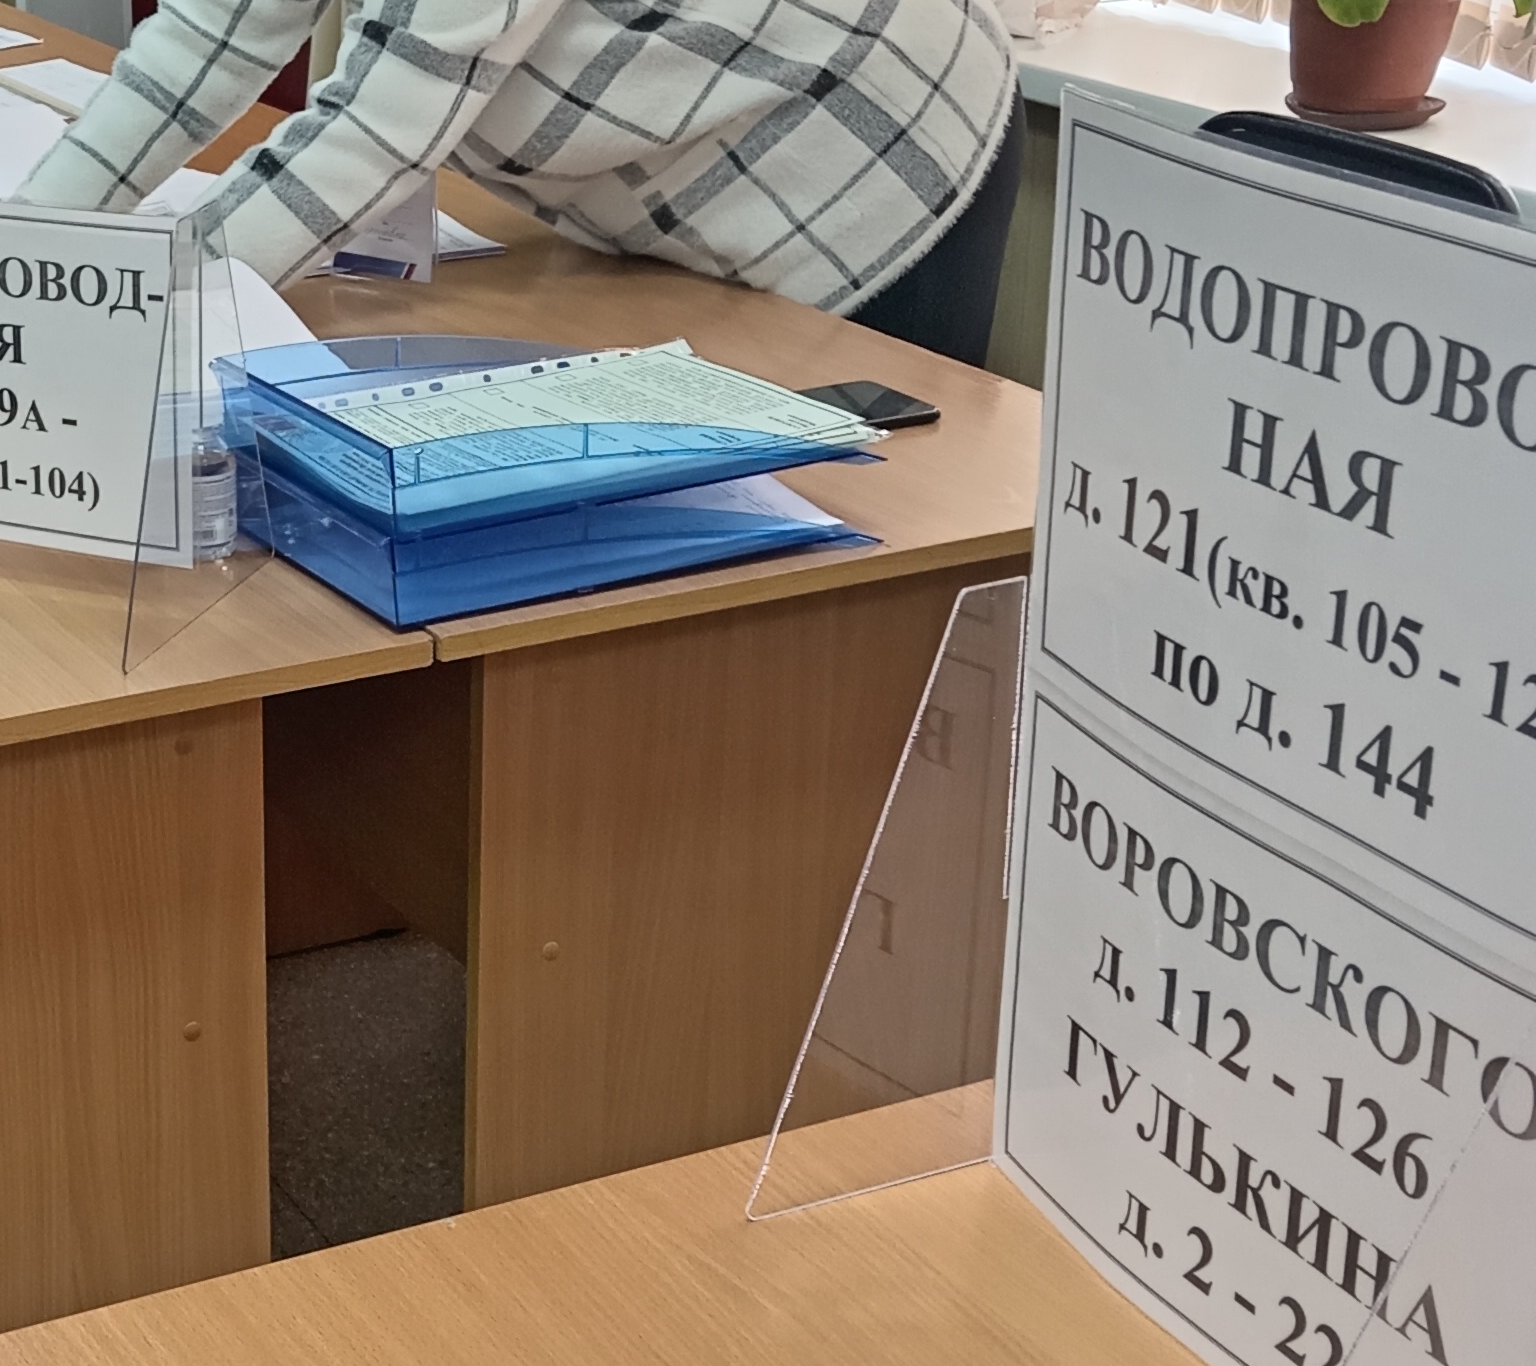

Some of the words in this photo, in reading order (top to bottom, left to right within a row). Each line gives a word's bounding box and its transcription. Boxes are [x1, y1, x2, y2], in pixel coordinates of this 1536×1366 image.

[1063, 460, 1102, 528] д.
[1118, 476, 1305, 631] 121(кв.
[1325, 589, 1425, 679] 105
[1221, 397, 1404, 540] НАЯ
[1150, 629, 1220, 707] по
[1235, 678, 1292, 752] д.
[1318, 702, 1435, 821] 144
[1047, 765, 1536, 1141] ВОРОВСКОГО
[1092, 934, 1136, 1004] д.
[1155, 967, 1252, 1083] 112
[1317, 1075, 1433, 1200] 126
[1117, 1189, 1164, 1260] д.
[1181, 1225, 1214, 1297] 2
